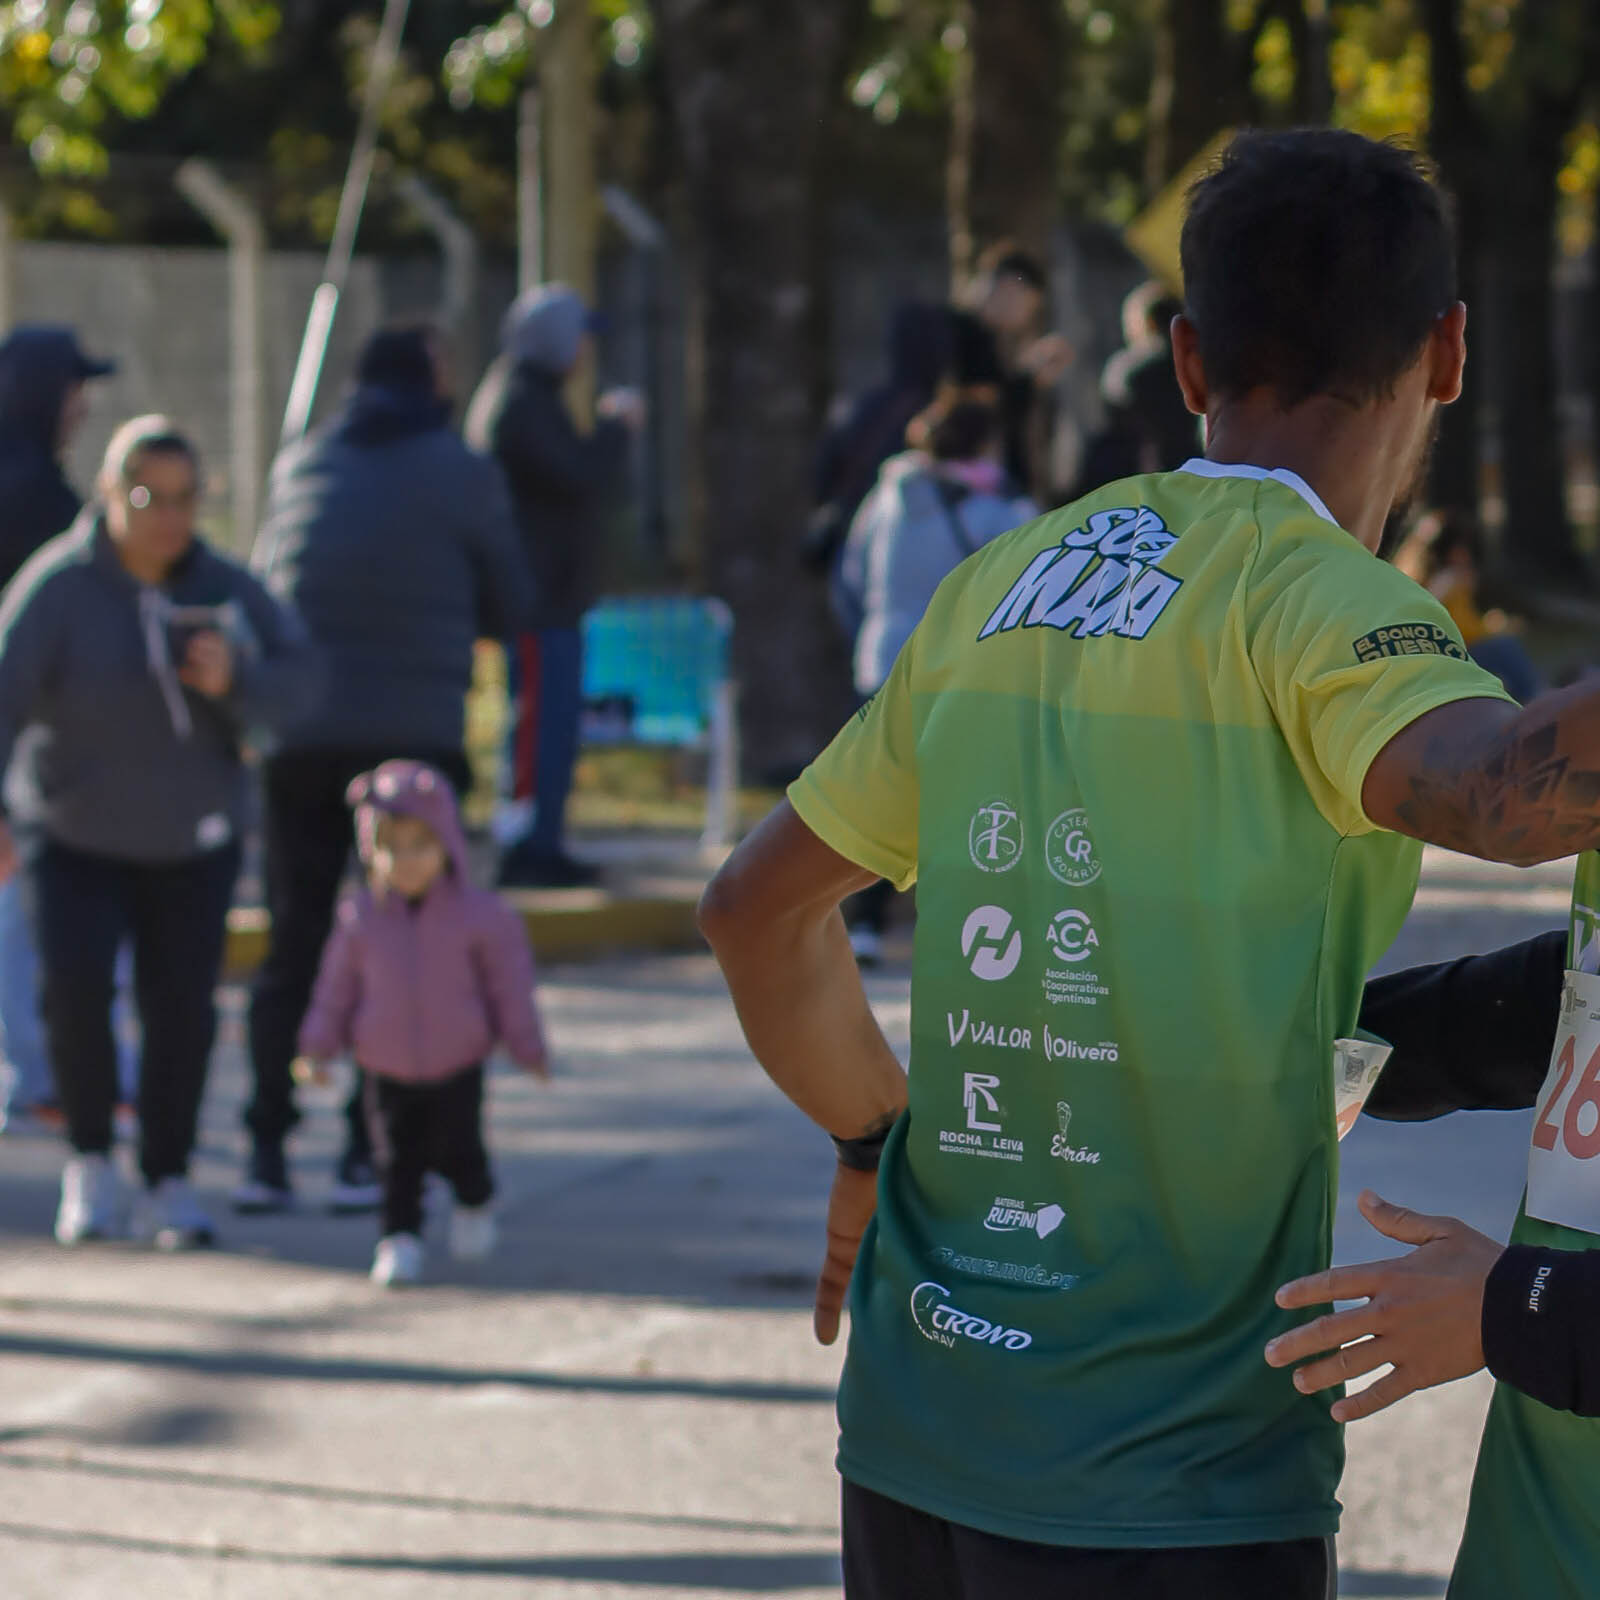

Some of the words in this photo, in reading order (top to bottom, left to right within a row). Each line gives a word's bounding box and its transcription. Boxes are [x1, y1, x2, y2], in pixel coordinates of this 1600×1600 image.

[1376, 626, 1428, 643] BONO
[1053, 856, 1100, 880] ROSARIO
[1046, 922, 1100, 948] ACA
[970, 1020, 1032, 1050] VALOR
[1053, 1037, 1118, 1062] Olivero
[939, 1130, 983, 1147] ROCHA
[992, 1136, 1024, 1152] LEIVA
[987, 1205, 1038, 1230] RUFFINI
[1528, 1266, 1553, 1312] Dufour
[930, 1330, 956, 1349] RAV
